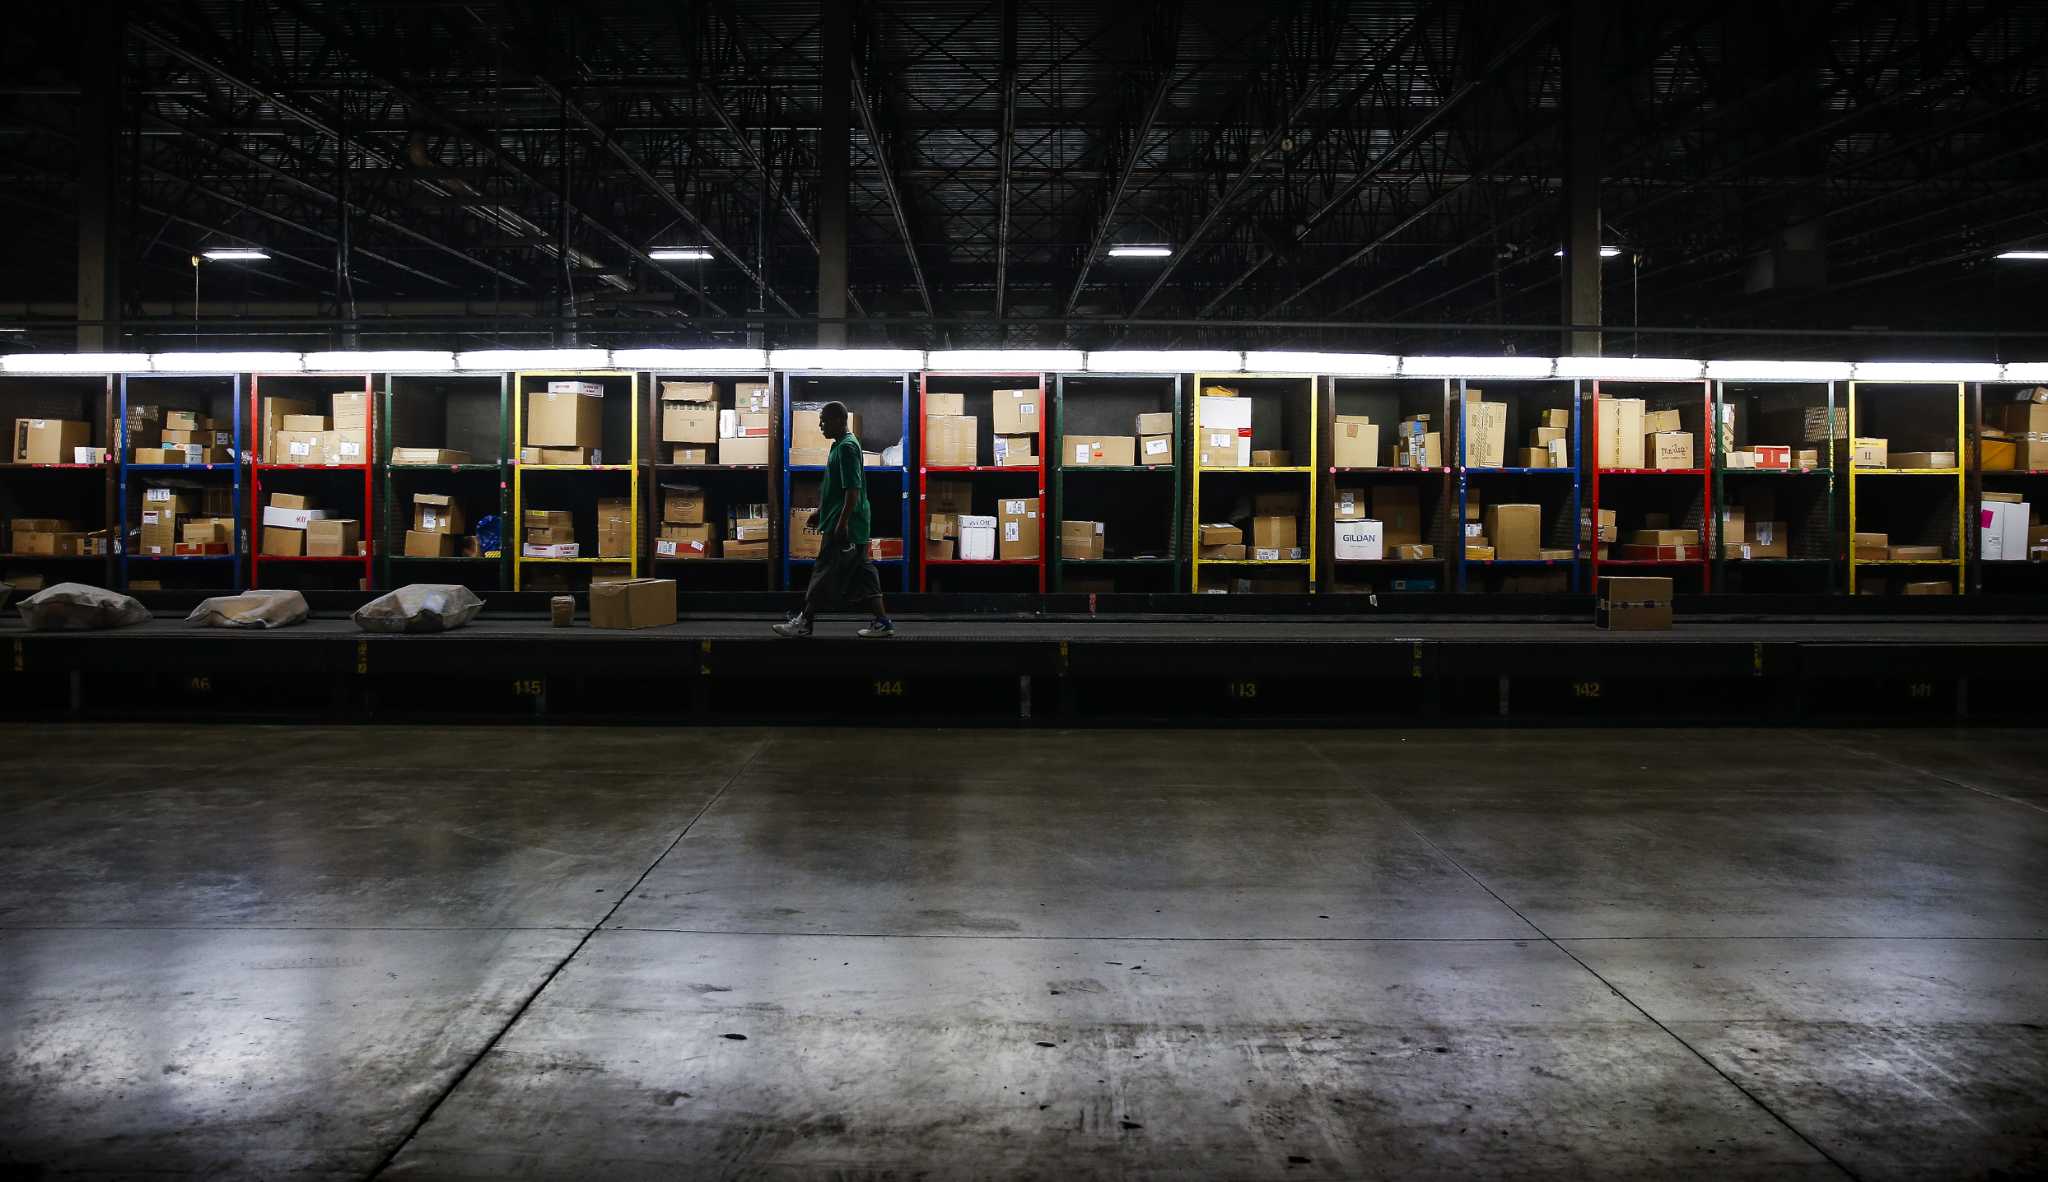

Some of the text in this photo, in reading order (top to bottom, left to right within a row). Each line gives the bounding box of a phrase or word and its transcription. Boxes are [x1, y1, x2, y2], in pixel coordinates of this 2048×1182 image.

[1342, 534, 1376, 543] GILDAN
[873, 680, 902, 696] 144
[1573, 682, 1600, 697] 142
